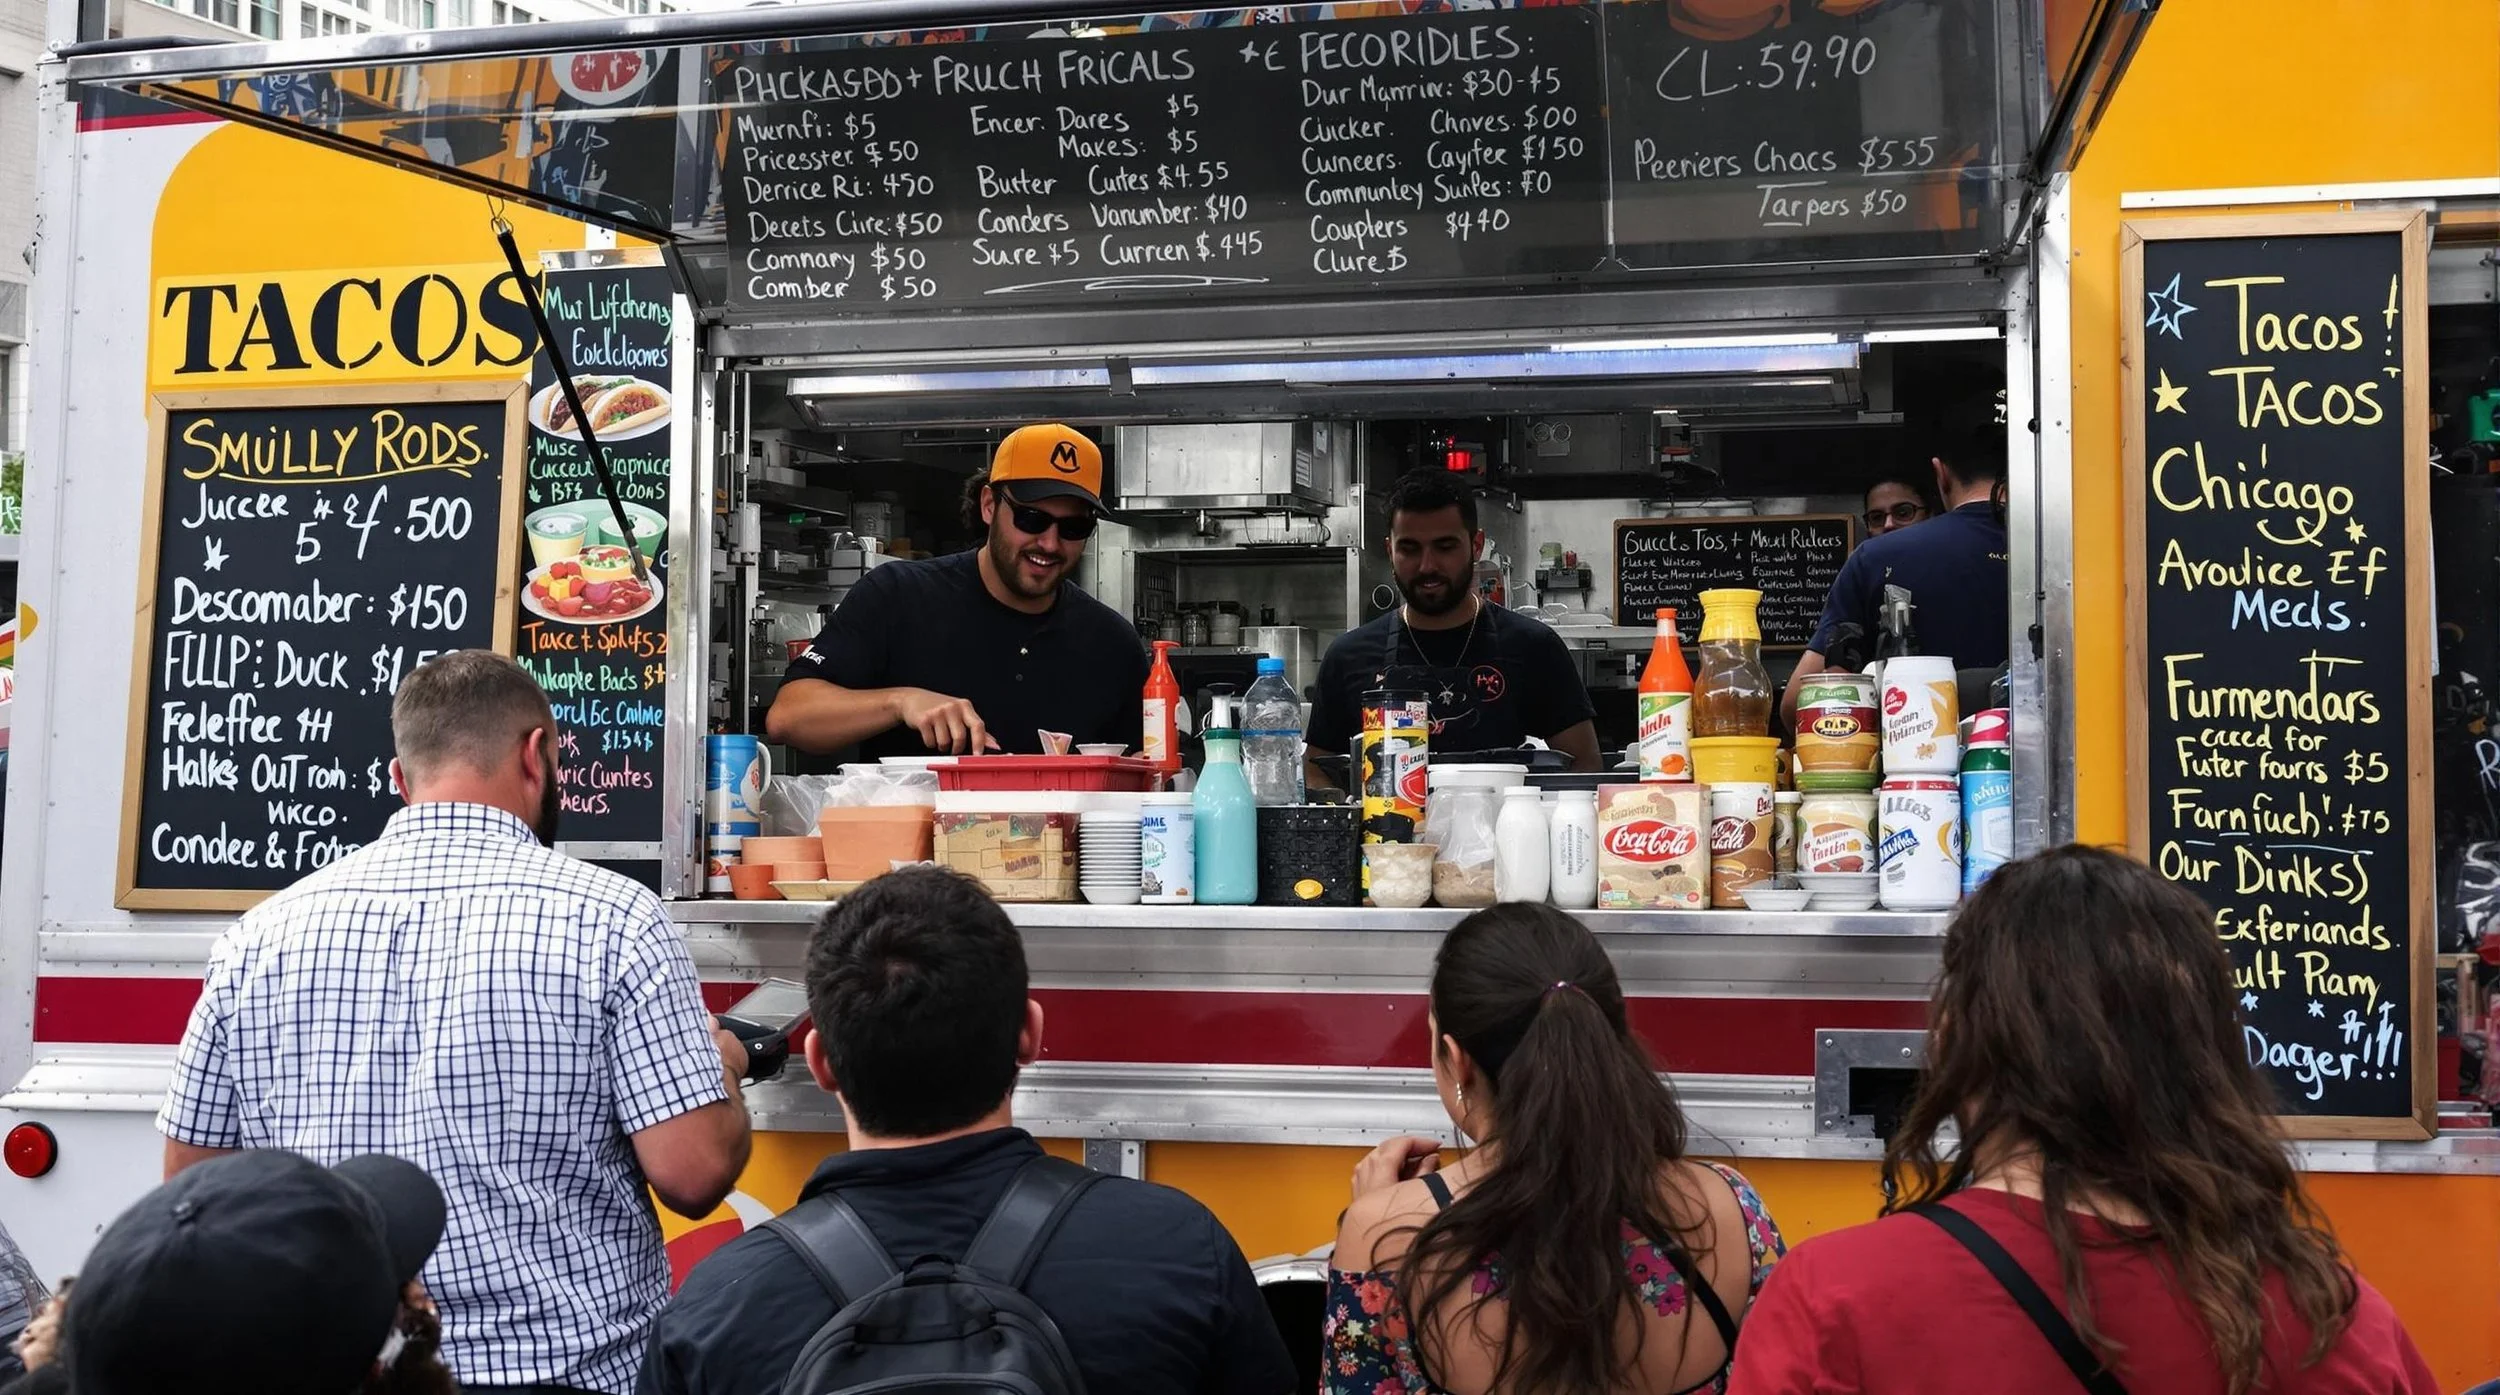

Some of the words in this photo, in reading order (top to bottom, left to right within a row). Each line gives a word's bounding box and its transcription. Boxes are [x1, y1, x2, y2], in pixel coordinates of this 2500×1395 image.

[844, 111, 877, 141] $5
[1056, 105, 1131, 133] Dares
[1167, 126, 1199, 154] $5
[870, 240, 926, 275] $50
[162, 268, 544, 376] TACOS
[2203, 276, 2364, 357] Tacos
[2207, 365, 2385, 429] TACOS
[2151, 440, 2355, 549] Chicago
[387, 582, 468, 632] $150
[2284, 725, 2329, 753] for
[2343, 749, 2389, 787] $5
[264, 830, 287, 870] &
[2159, 839, 2221, 883] Our
